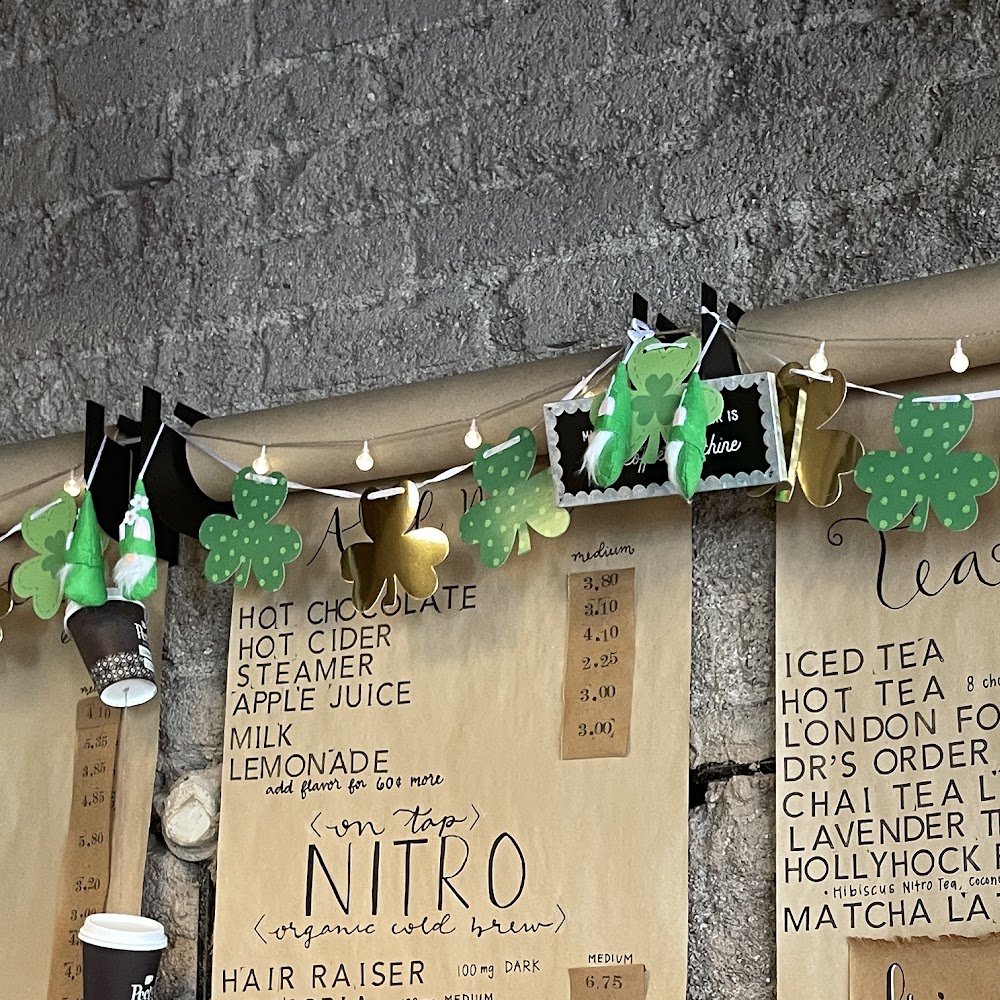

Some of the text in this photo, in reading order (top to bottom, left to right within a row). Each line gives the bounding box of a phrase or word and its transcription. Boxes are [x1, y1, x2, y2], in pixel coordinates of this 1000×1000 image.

[728, 410, 738, 421] IS
[572, 542, 634, 562] medium
[584, 573, 618, 591] 3.80
[309, 624, 391, 653] CIDER
[584, 625, 618, 642] 4.10
[237, 654, 373, 687] STEAMER
[582, 652, 618, 670] 2.25
[785, 639, 944, 679] ICED TEA
[232, 681, 411, 716] APPLE JUICE
[580, 684, 616, 701] 3.00
[782, 687, 852, 716] HOT
[230, 723, 293, 750] MILK
[784, 710, 937, 748] LONDON
[230, 749, 389, 781] LEMONADE
[784, 750, 857, 783] DR'S
[874, 739, 988, 775] ORDER
[300, 777, 341, 798] flavor
[783, 788, 872, 820] CHAI
[893, 778, 964, 810] TEA
[789, 811, 964, 852] LAVENDER
[305, 831, 525, 916] NITRO
[785, 844, 979, 883] HOLLYHOCK
[391, 914, 456, 936] cold
[784, 901, 931, 932] MATCHA
[312, 961, 425, 989] RAISER
